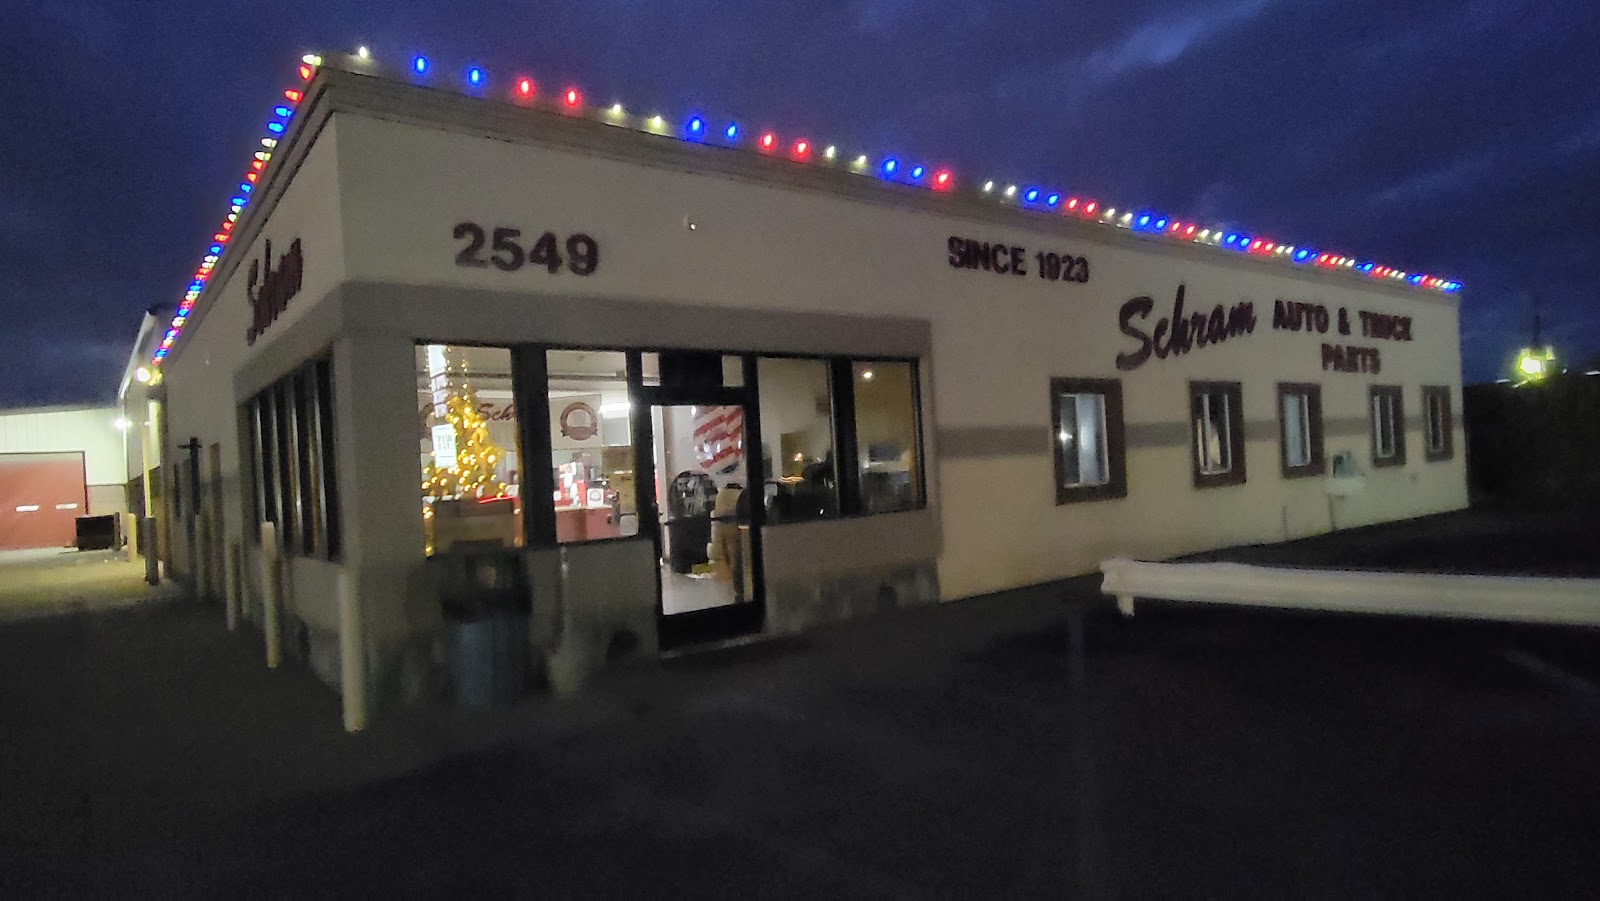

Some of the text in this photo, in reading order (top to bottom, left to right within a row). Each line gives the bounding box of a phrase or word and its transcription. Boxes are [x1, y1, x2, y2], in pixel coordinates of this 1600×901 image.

[454, 222, 599, 276] 2549
[948, 236, 1090, 283] SINCE 1923
[1117, 282, 1256, 371] Schram
[1273, 299, 1413, 342] AUTO & TRUCK
[1321, 342, 1381, 375] PARTS
